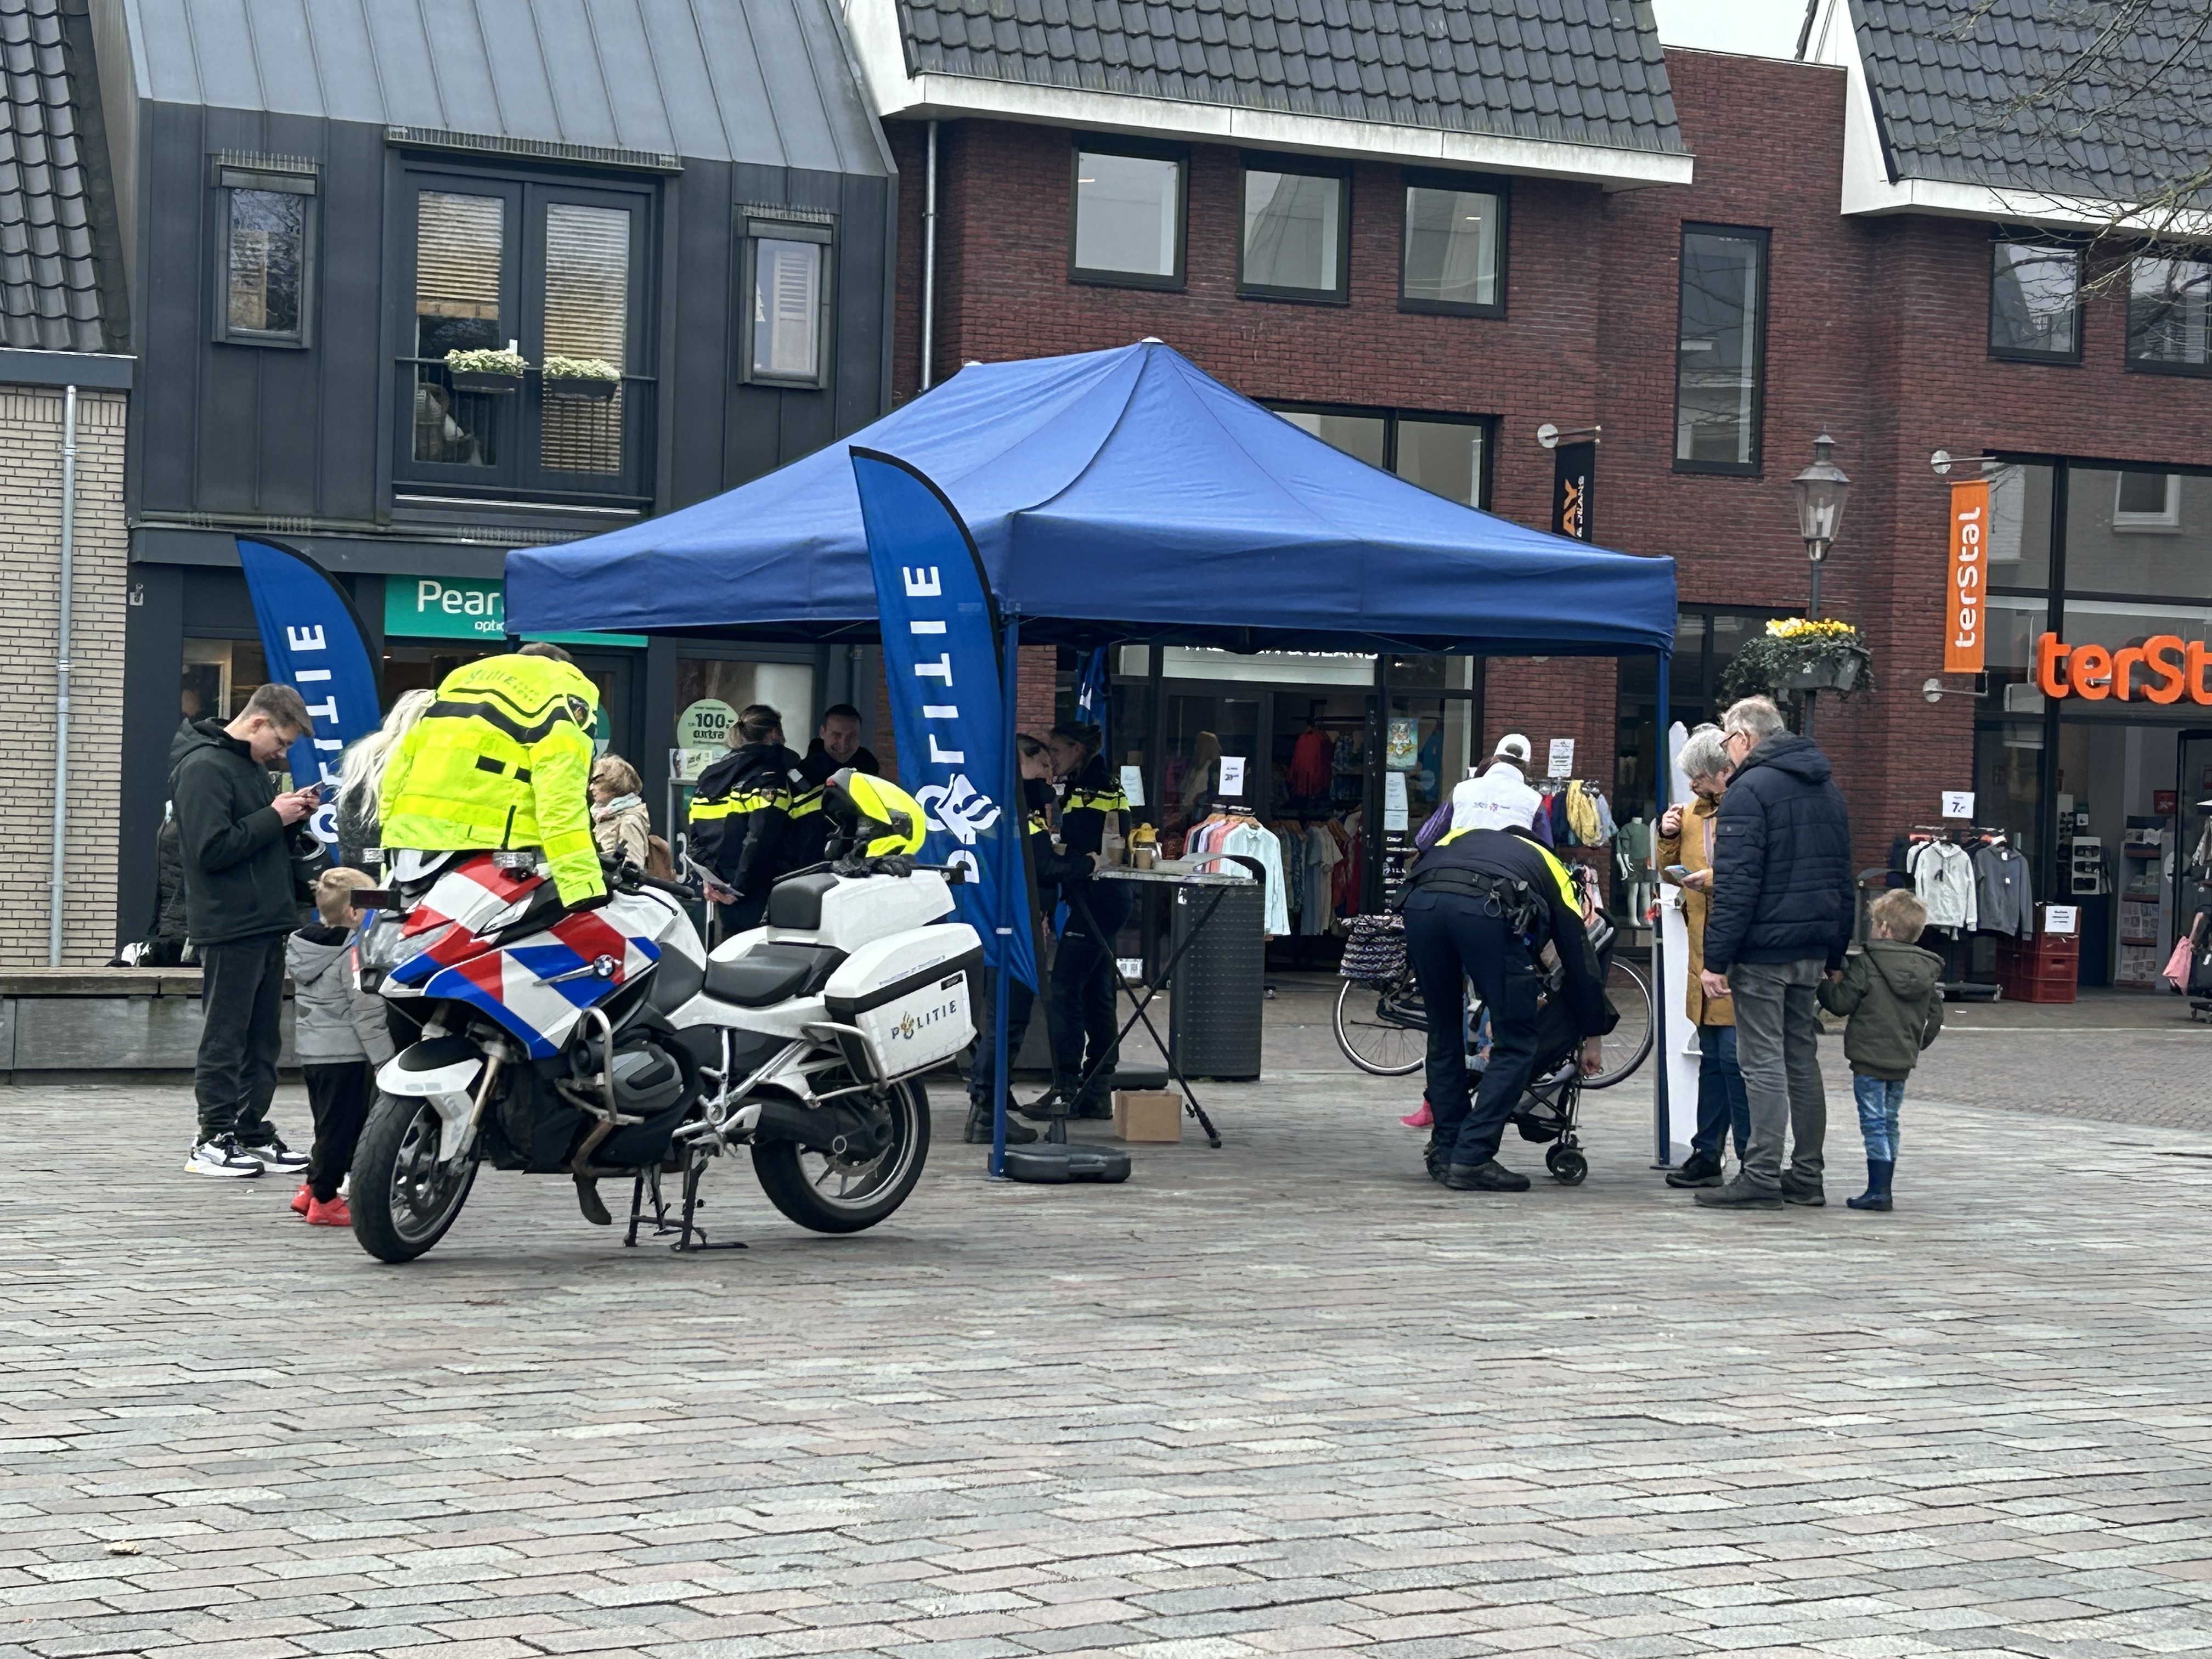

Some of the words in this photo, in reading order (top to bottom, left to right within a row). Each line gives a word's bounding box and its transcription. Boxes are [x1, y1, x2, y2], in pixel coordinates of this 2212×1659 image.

[1955, 506, 1981, 648] terStal
[417, 580, 504, 615] Pear
[890, 1000, 957, 1040] POLITIE
